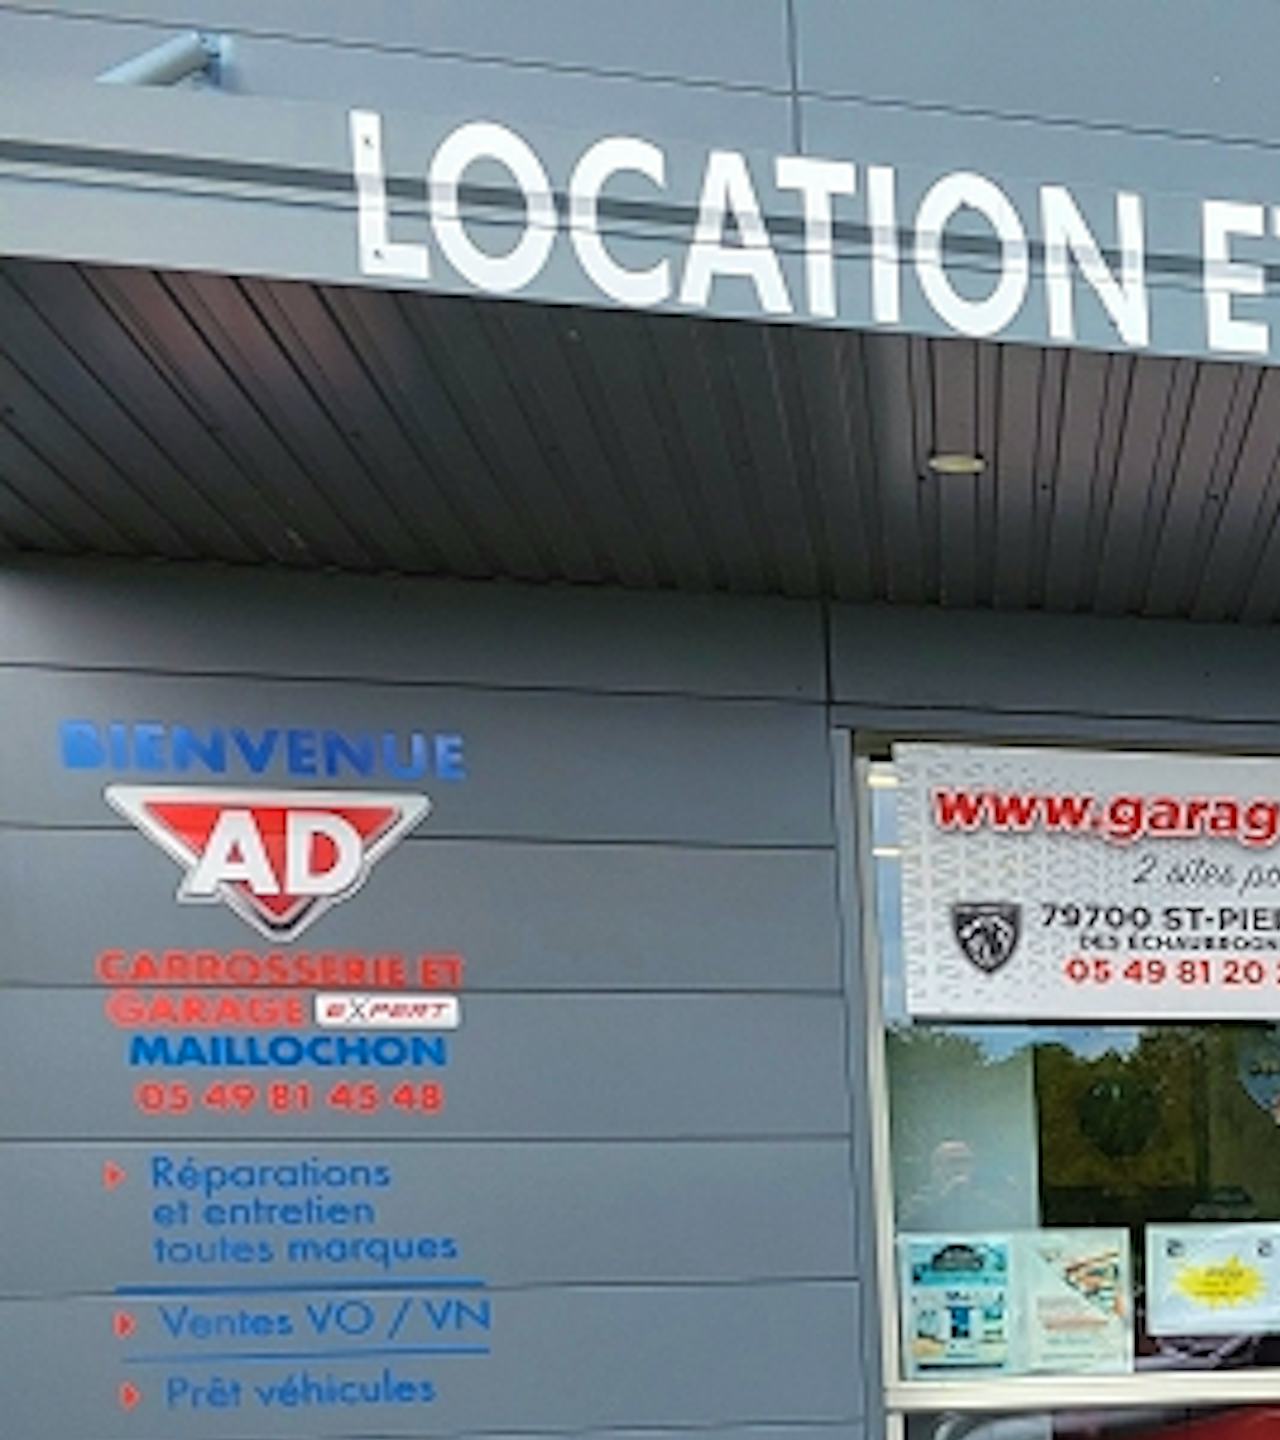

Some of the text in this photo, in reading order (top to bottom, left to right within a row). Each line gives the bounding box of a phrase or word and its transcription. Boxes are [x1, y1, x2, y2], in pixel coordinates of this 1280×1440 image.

[347, 111, 1151, 346] LOCATION
[57, 719, 466, 781] BIENVENUE
[183, 810, 364, 896] AD
[1133, 856, 1158, 885] 2
[1166, 858, 1236, 887] sites
[1040, 903, 1151, 931] 79700
[99, 951, 461, 986] CARROSSERIE ET
[1067, 959, 1111, 984] 05
[1124, 960, 1166, 984] 49
[1180, 960, 1210, 984] 81
[1224, 960, 1265, 984] 20
[106, 989, 306, 1027] GARAGE
[129, 1036, 446, 1066] MAILLOCHON
[137, 1082, 444, 1112] 05 49 81 45 48
[151, 1155, 390, 1197] Réparations
[153, 1196, 375, 1227] et entretien
[155, 1232, 458, 1268] toutes marques
[158, 1300, 490, 1339] Ventes VO / VN
[166, 1374, 436, 1409] Prêt véhicules
